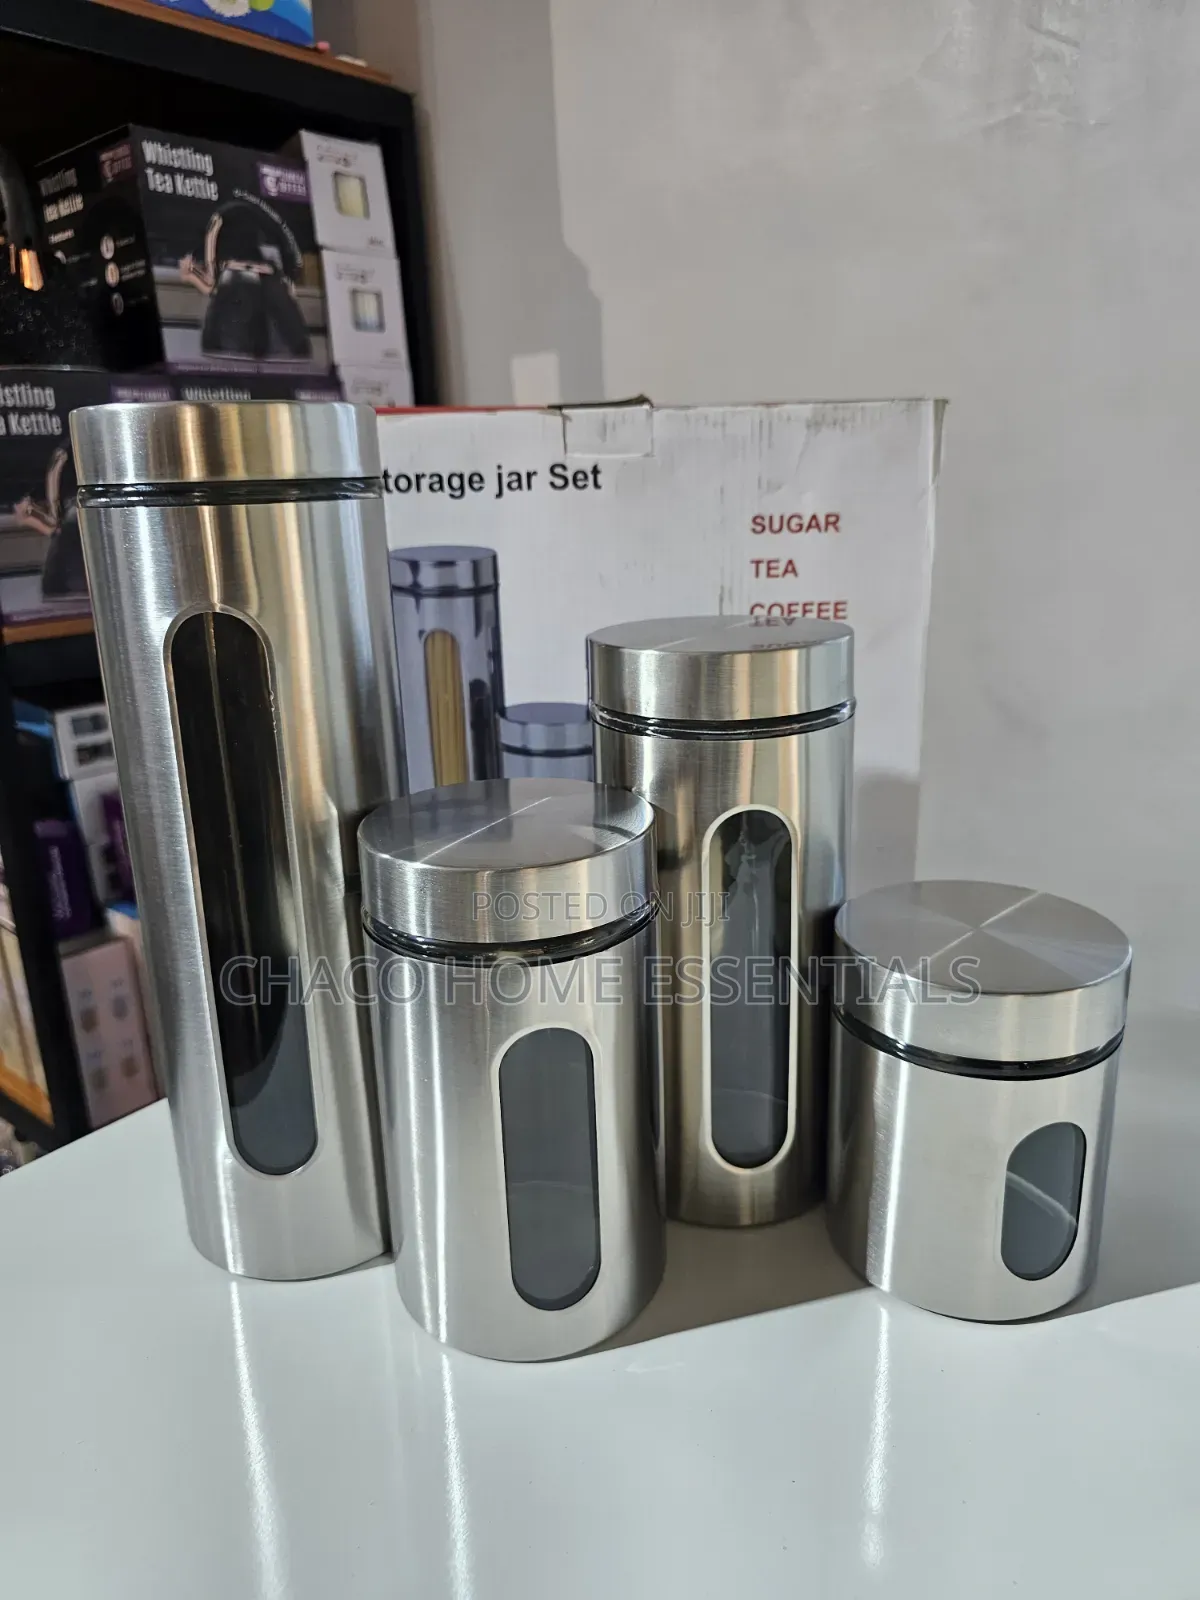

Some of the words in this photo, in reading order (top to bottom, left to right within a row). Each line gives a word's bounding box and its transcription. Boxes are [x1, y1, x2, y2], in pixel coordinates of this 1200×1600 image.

[141, 139, 213, 176] Whistling
[145, 167, 173, 193] Tea
[174, 172, 219, 201] Kettle
[8, 411, 62, 436] Kettle
[382, 468, 485, 499] torage
[495, 465, 538, 499] jar
[549, 463, 602, 490] Set
[751, 513, 841, 534] SUGAR
[750, 559, 798, 578] TEA
[750, 601, 848, 620] COFFEE
